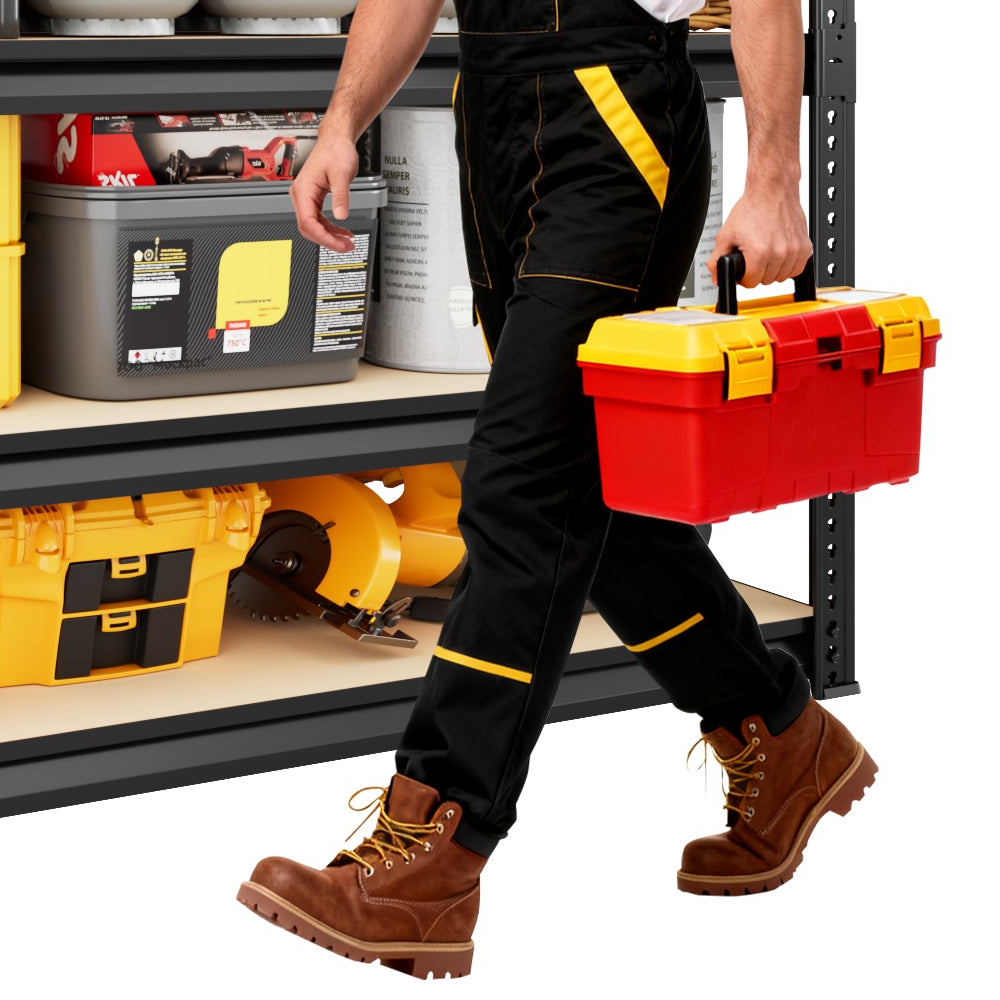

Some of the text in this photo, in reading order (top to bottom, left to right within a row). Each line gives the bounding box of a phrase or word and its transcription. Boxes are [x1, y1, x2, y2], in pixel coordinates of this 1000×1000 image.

[384, 155, 408, 166] NULLA
[382, 170, 410, 181] SEMPER
[387, 185, 410, 196] AURIS
